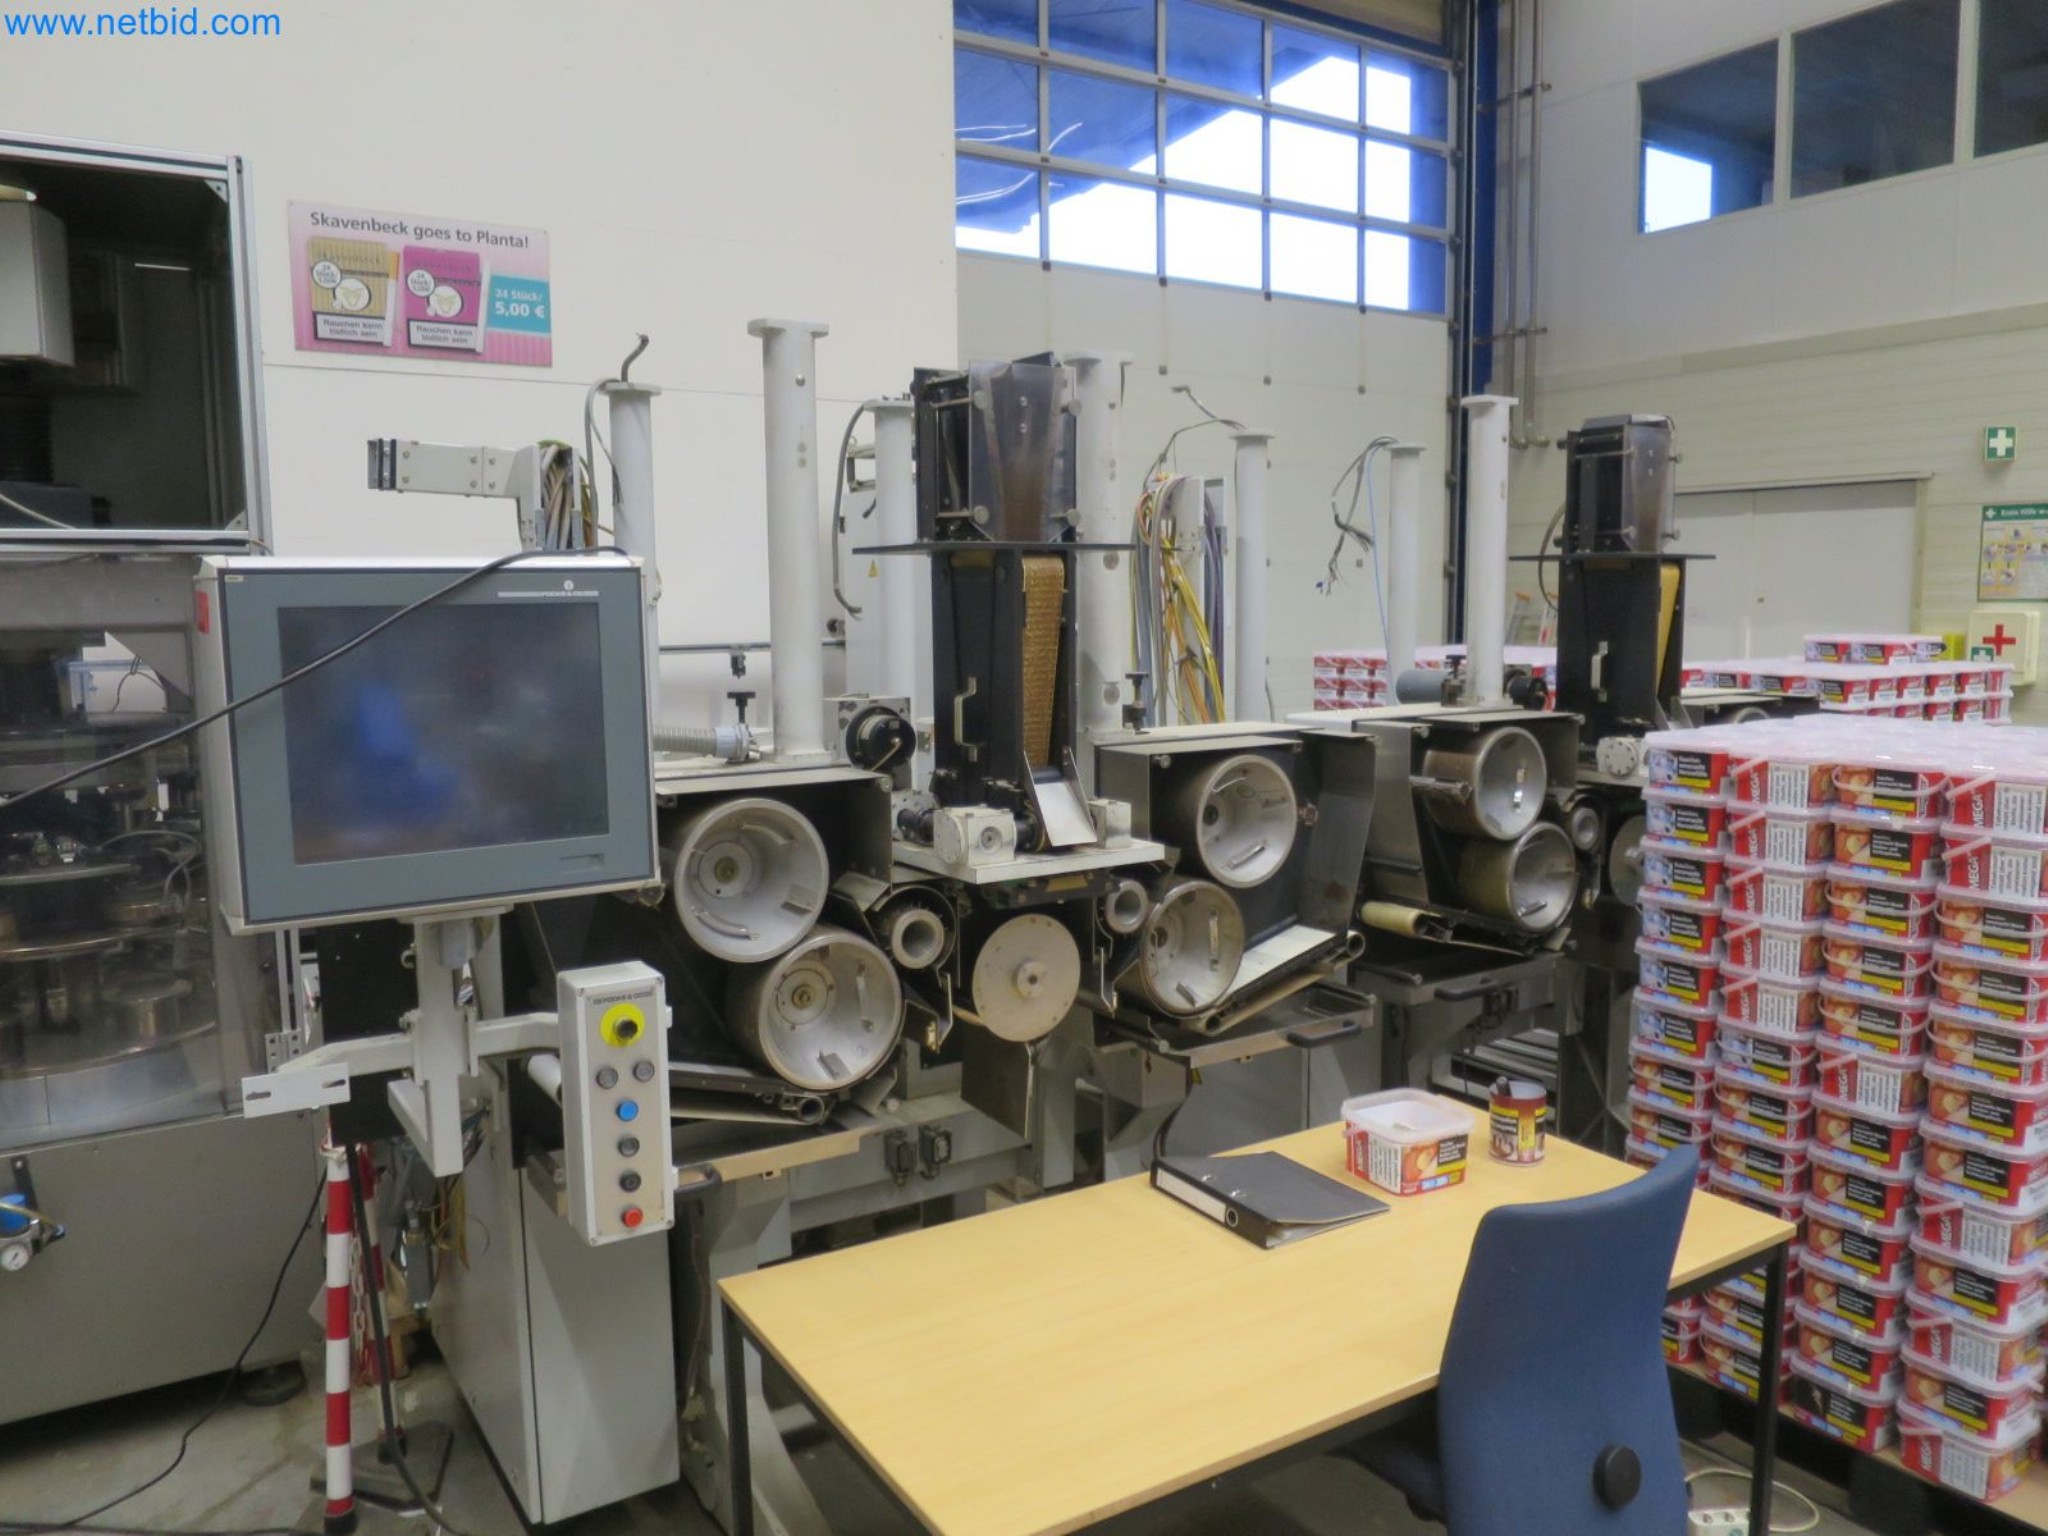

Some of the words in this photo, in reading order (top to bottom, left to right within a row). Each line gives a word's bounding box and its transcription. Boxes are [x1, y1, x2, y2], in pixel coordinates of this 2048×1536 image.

[310, 211, 408, 235] Skavenbeck
[413, 225, 452, 240] goes
[456, 229, 472, 242] to
[476, 229, 529, 248] Planta!
[495, 301, 530, 317] 5,00
[534, 304, 545, 319] €
[1972, 792, 1984, 829] MEGA
[1968, 855, 1980, 889] MEGA
